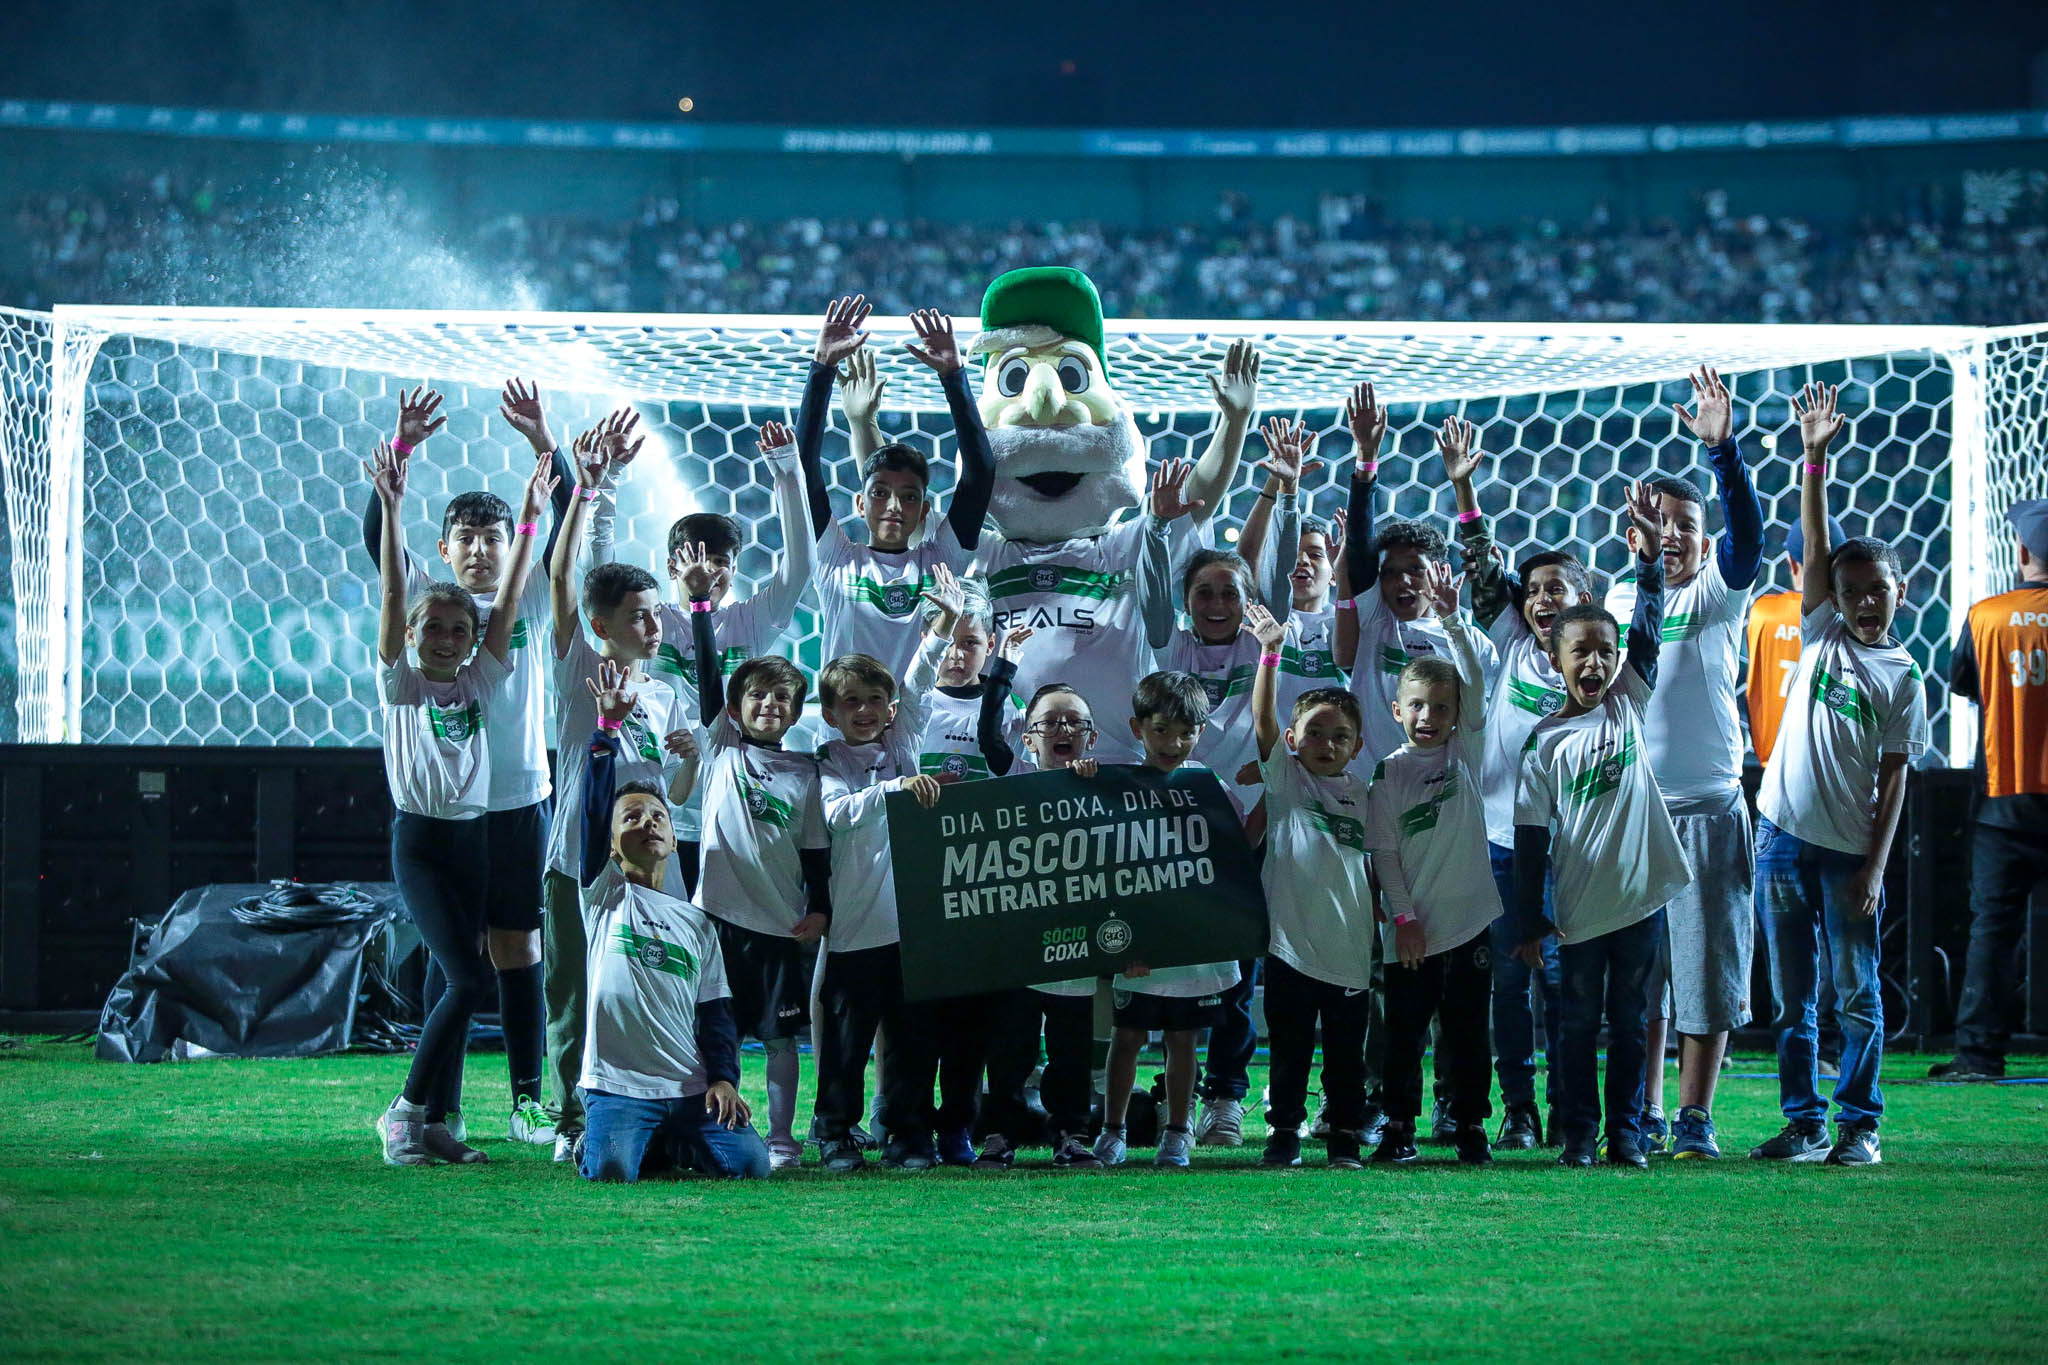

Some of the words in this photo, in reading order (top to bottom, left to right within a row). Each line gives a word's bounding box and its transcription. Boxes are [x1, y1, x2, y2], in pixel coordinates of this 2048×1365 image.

[992, 607, 1095, 633] REALS
[1774, 624, 1801, 640] AP
[2008, 611, 2048, 627] APO
[2009, 649, 2046, 688] 39
[941, 811, 985, 837] DIA
[996, 805, 1028, 830] DE
[1040, 795, 1113, 823] COXA,
[1122, 789, 1164, 812] DIA
[1168, 789, 1199, 808] DE
[942, 814, 1210, 887] MASCOTINHO
[943, 879, 1059, 919] ENTRAR
[1065, 872, 1107, 903] EM
[1115, 857, 1215, 896] CAMPO
[1044, 941, 1089, 963] COXA
